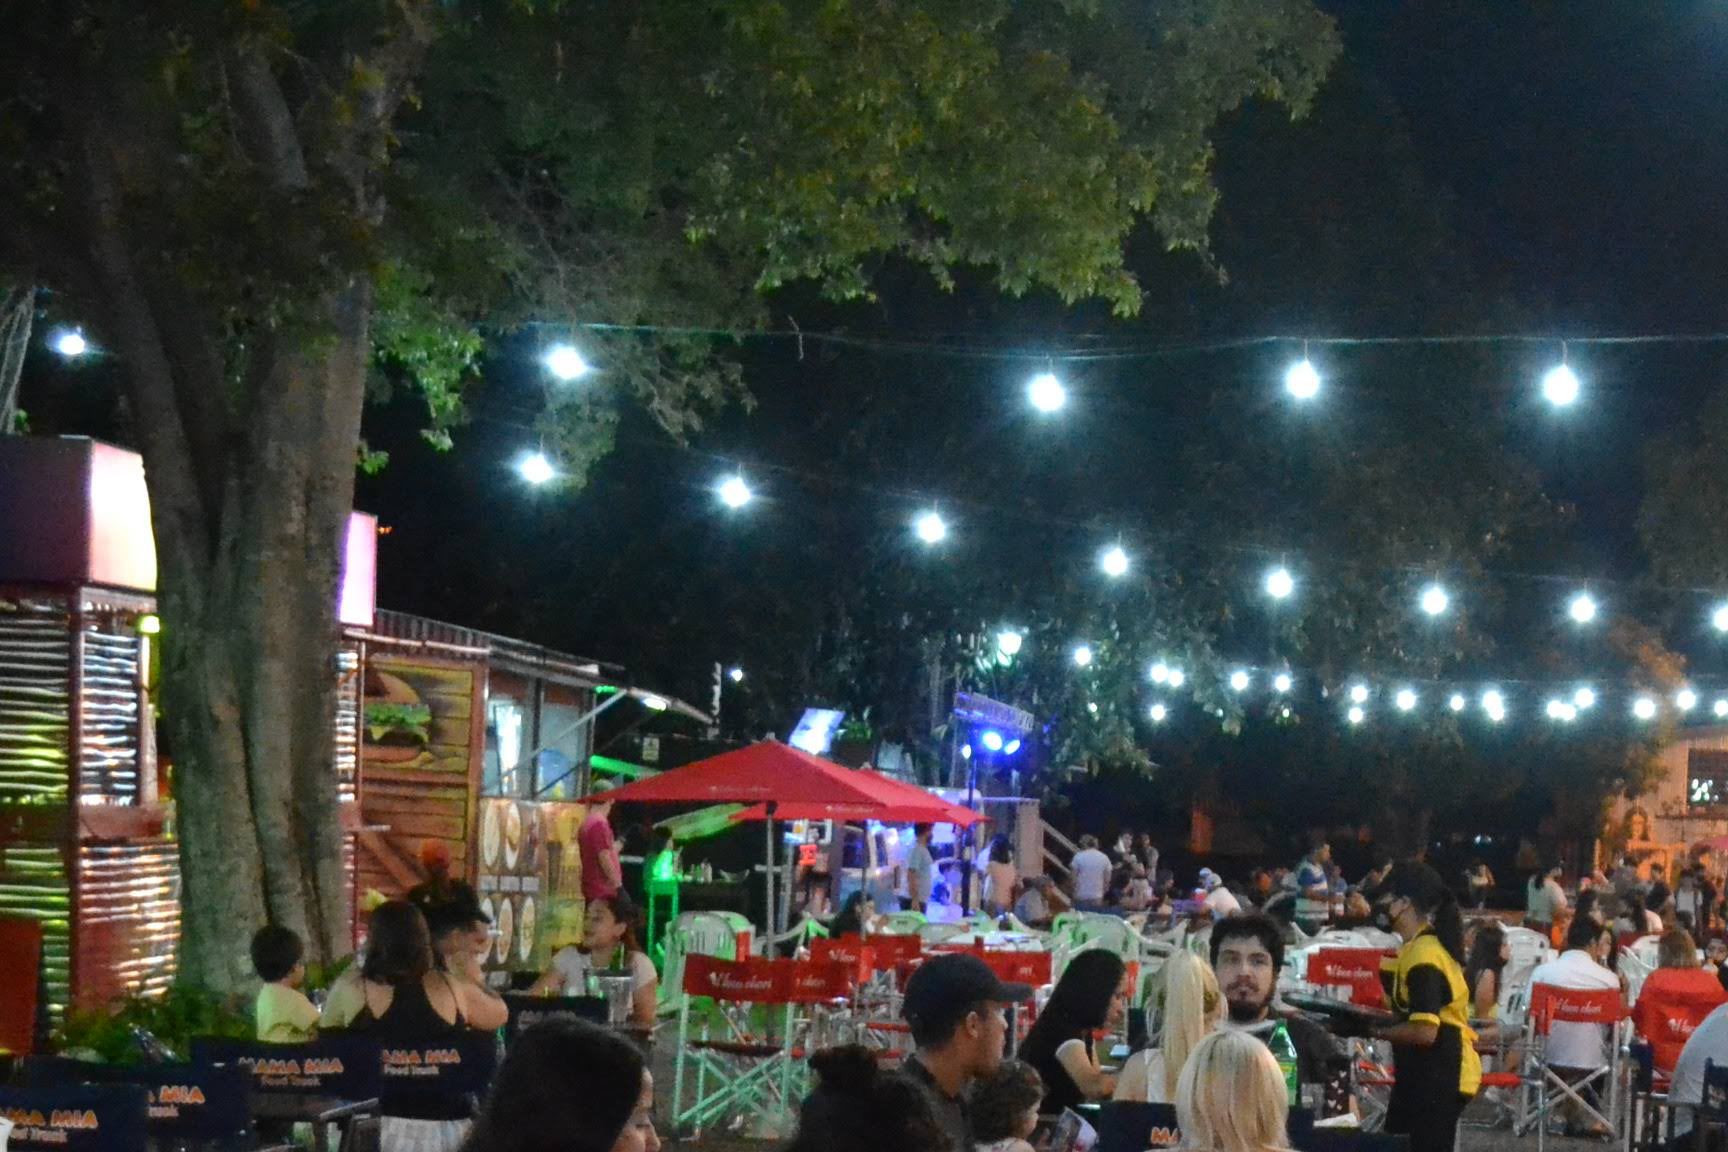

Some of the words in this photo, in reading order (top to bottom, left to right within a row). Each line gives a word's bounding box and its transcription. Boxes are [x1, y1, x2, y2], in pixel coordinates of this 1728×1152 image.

[304, 1056, 344, 1074] MIA
[425, 1049, 461, 1064] MIA
[159, 1084, 206, 1104] MIA
[51, 1109, 98, 1129] MIA
